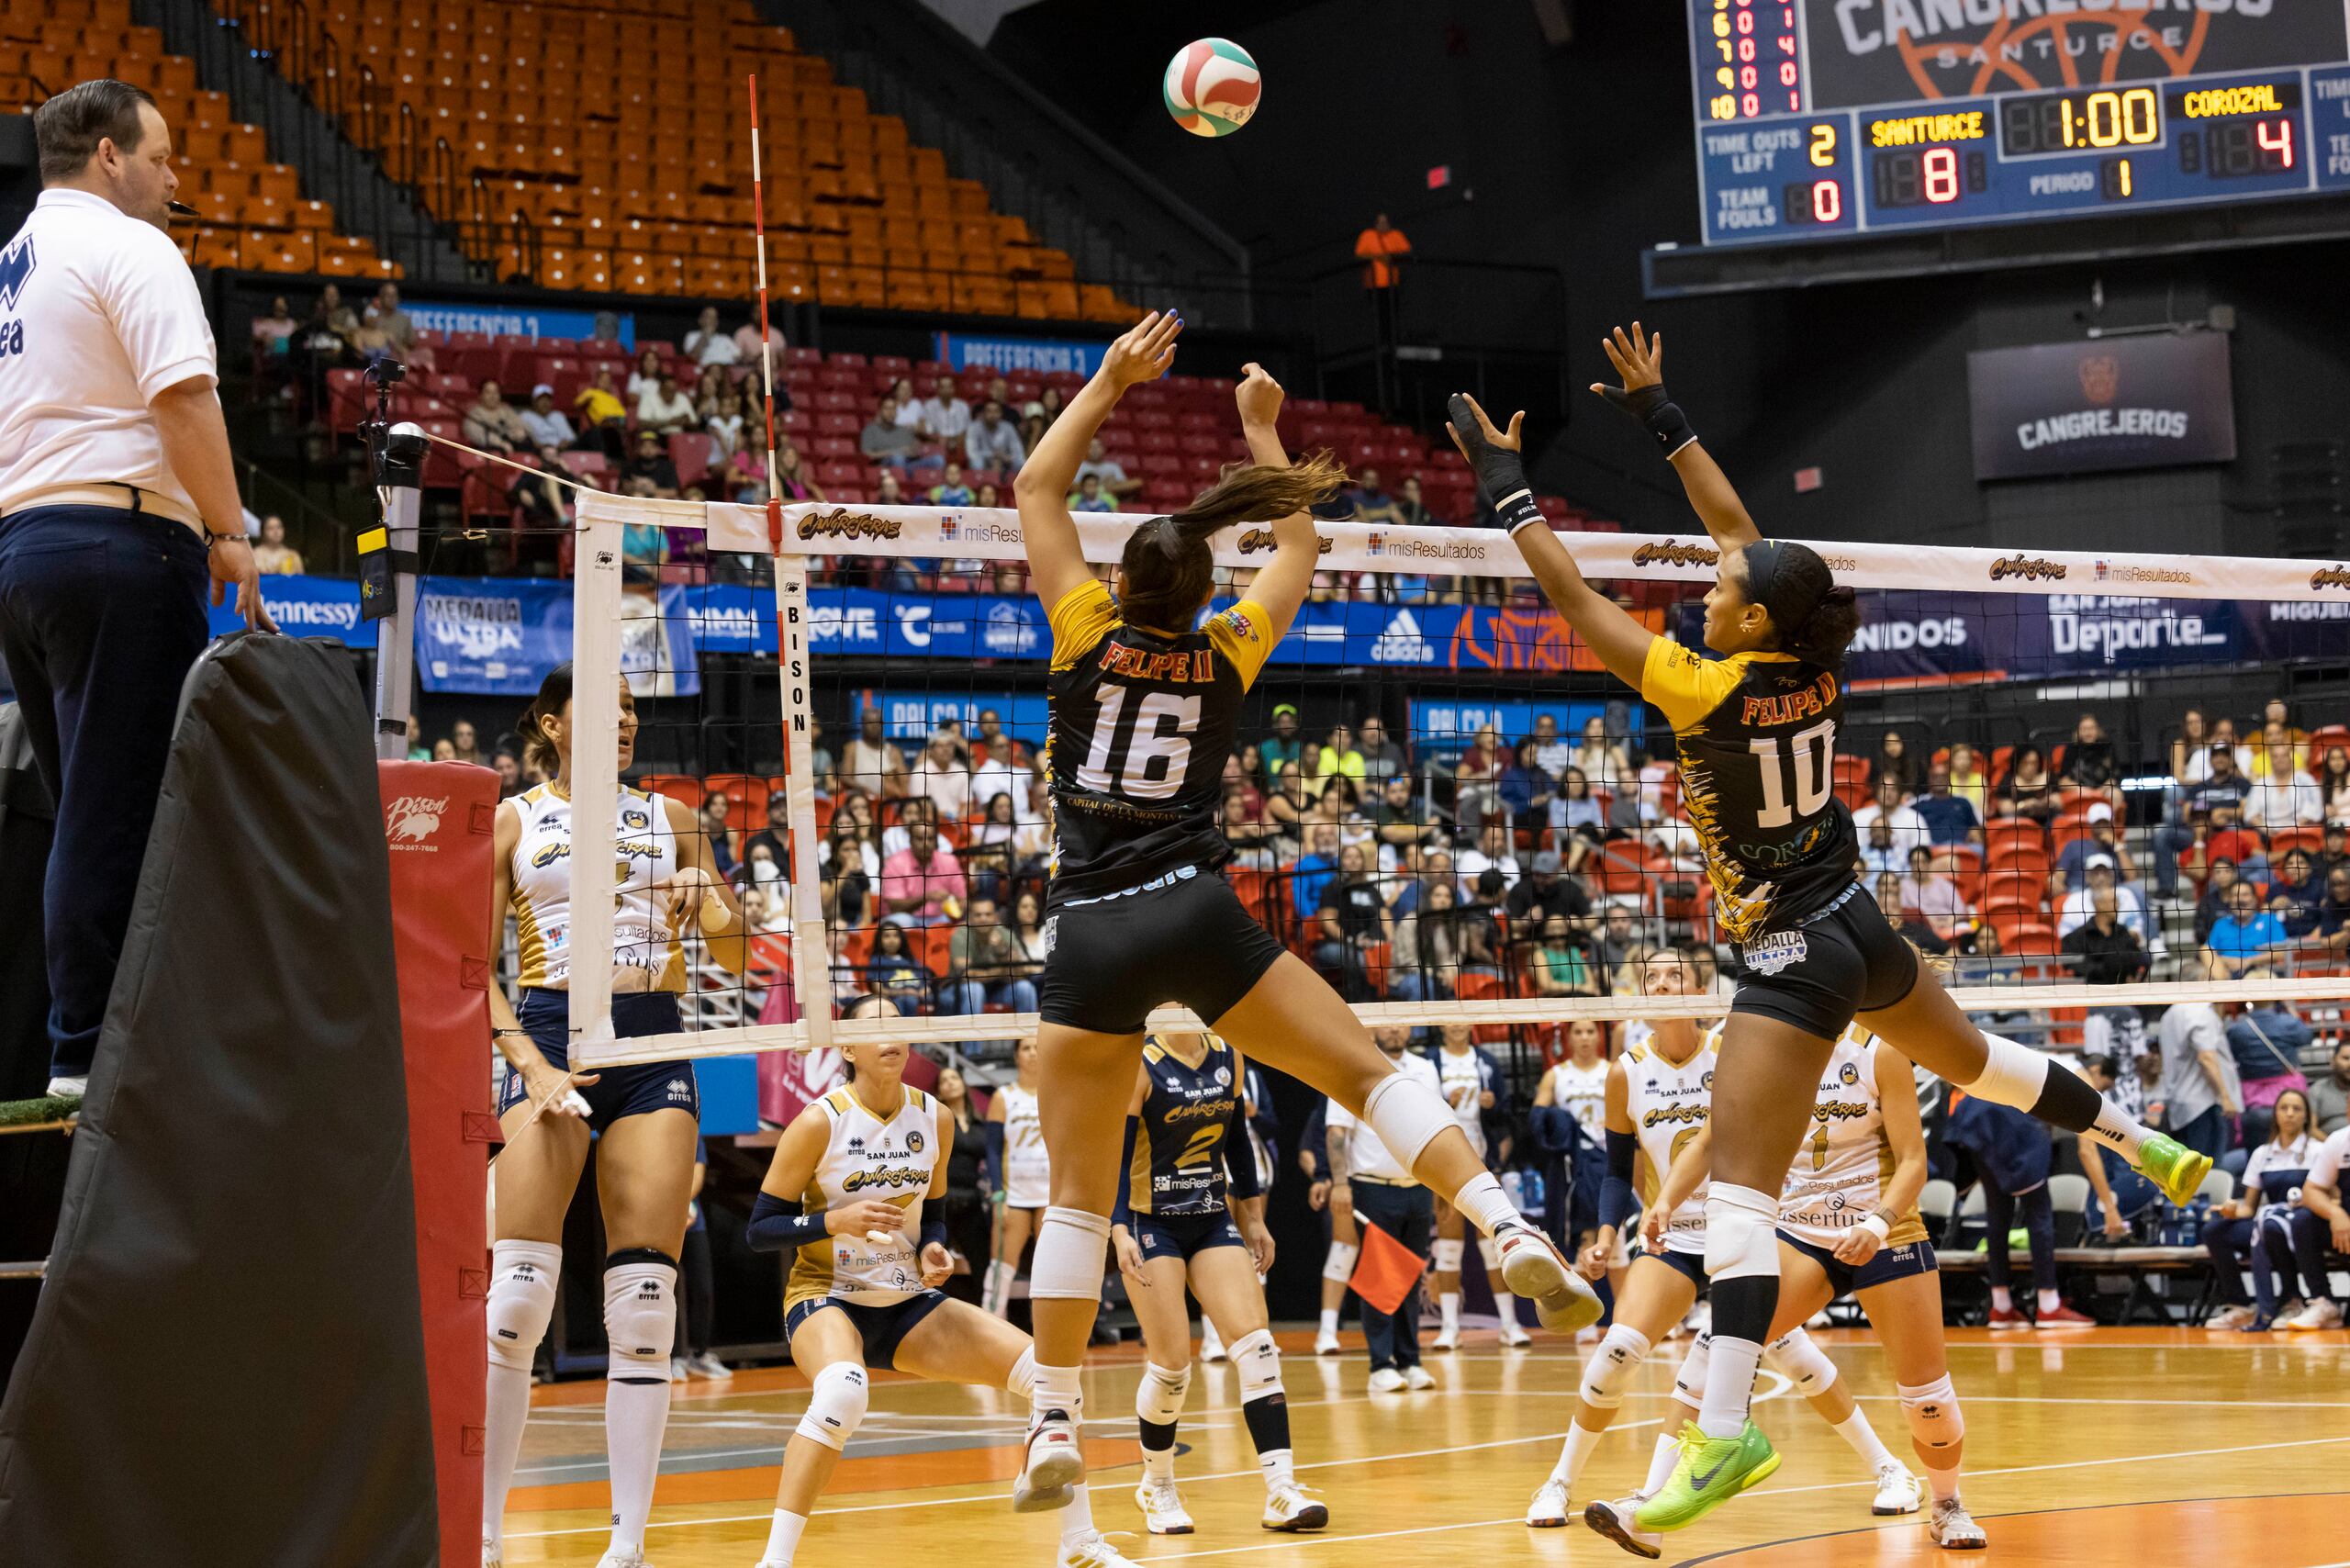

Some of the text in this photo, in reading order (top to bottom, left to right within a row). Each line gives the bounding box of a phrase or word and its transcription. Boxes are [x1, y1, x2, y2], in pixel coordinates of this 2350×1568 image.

[1713, 8, 1793, 37] 6 0 1
[1716, 36, 1795, 62] 7 0 4
[1937, 26, 2183, 69] SANTURCE
[1716, 62, 1796, 90] 9 0 0
[1710, 91, 1798, 120] 10 0 1
[2183, 85, 2283, 118] COROZAL
[1871, 111, 1985, 148] SANTURCE
[2060, 88, 2157, 149] 1:00
[1706, 128, 1802, 156] TIME OUTS
[1810, 124, 1835, 167] 2
[2255, 119, 2293, 168] 4
[1732, 151, 1775, 174] LEFT
[1922, 148, 1959, 204] 8
[2029, 173, 2096, 196] PERIOD
[2120, 160, 2132, 196] 1
[1718, 186, 1769, 208] TEAM
[1813, 180, 1841, 222] 0
[1718, 207, 1777, 230] FOULS
[2017, 408, 2189, 451] CANGREJEROS
[1388, 540, 1485, 560] misResultados
[2111, 566, 2192, 584] misResultados
[260, 594, 361, 631] ennessy
[424, 595, 522, 624] MEDALLA
[431, 621, 523, 650] ULTRA
[1844, 616, 1968, 654] NIDOS
[1098, 640, 1215, 683] FELIPE II
[1370, 641, 1435, 663] adidas
[788, 606, 806, 732] BISON
[1740, 685, 1822, 727] FELIPE
[1075, 682, 1202, 800] 16
[1757, 718, 1836, 829] 10
[540, 823, 563, 834] errea
[1744, 932, 1804, 955] MEDALLA
[1747, 947, 1804, 966] ULTRA
[1184, 1086, 1225, 1098] SAN JUAN
[1661, 1087, 1702, 1098] SAN JUAN
[1818, 1083, 1841, 1092] UAN
[867, 1151, 886, 1160] SAN
[888, 1150, 911, 1159] JUAN
[1173, 1123, 1224, 1170] 2
[1810, 1125, 1829, 1172] 1
[1893, 1252, 1915, 1262] errea
[512, 1273, 534, 1282] errea
[845, 1375, 862, 1386] errea
